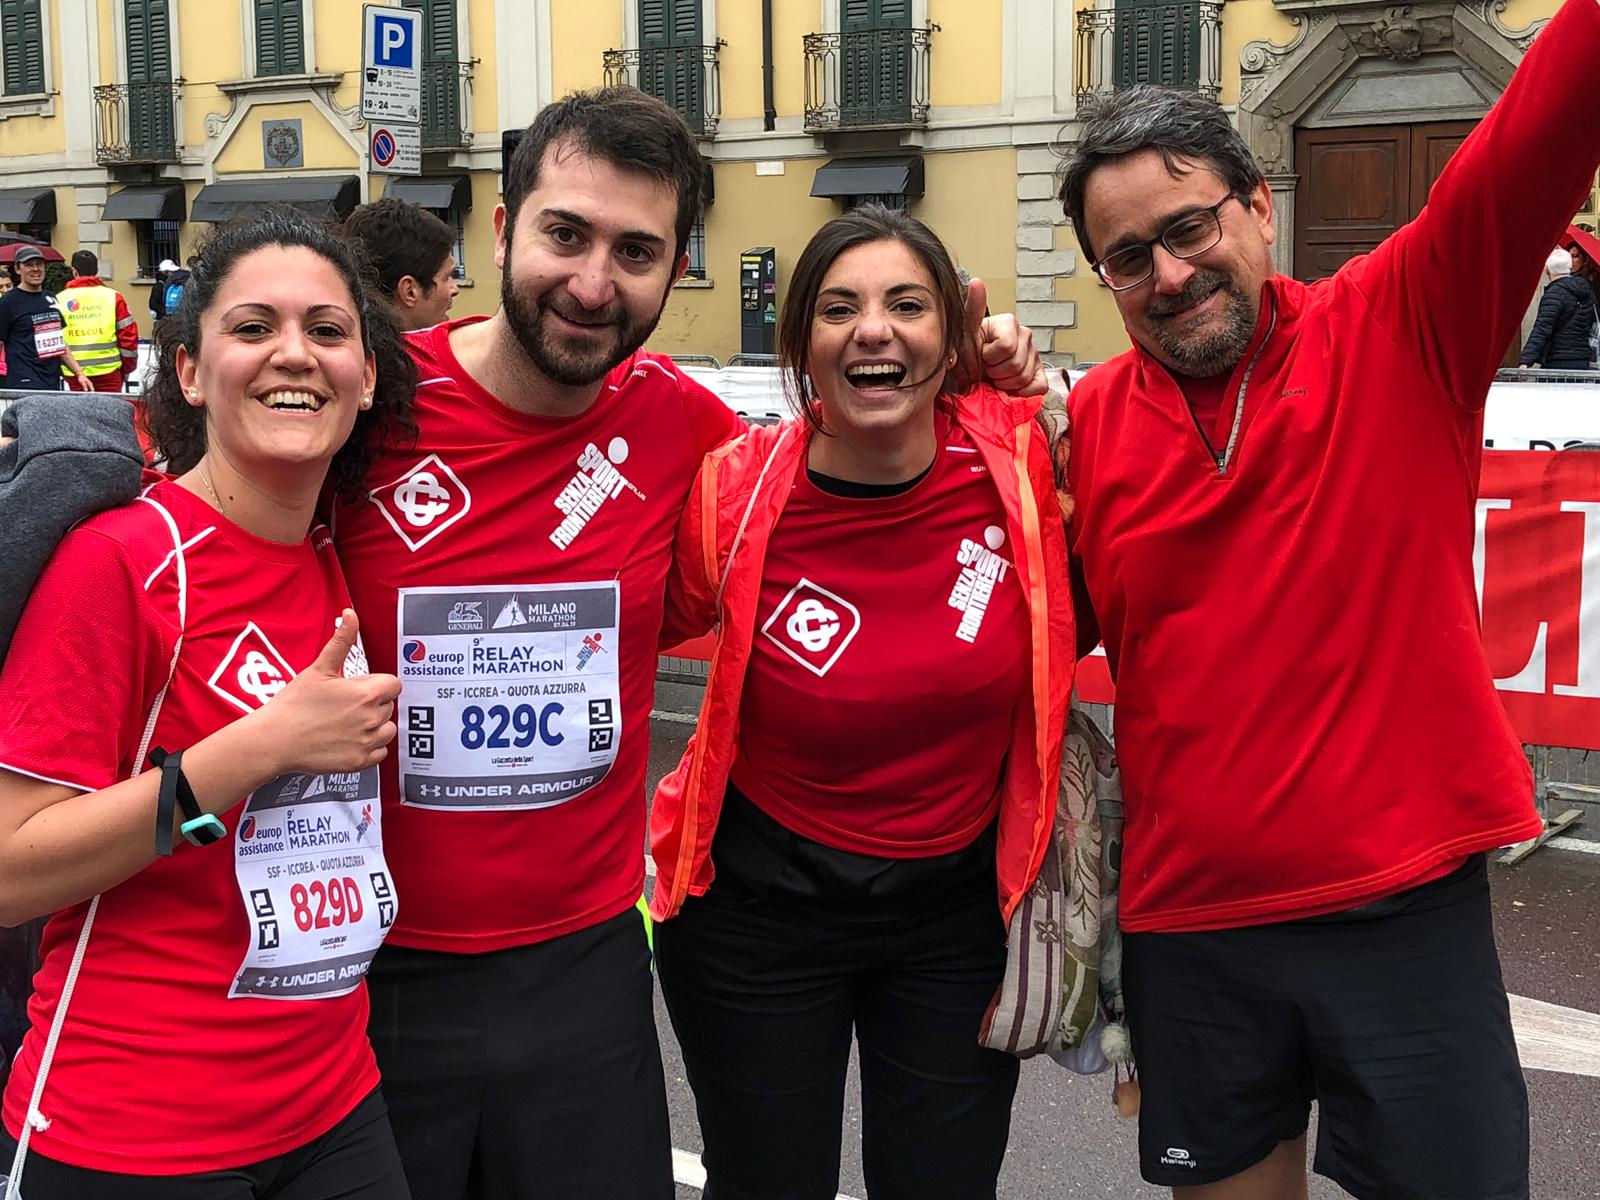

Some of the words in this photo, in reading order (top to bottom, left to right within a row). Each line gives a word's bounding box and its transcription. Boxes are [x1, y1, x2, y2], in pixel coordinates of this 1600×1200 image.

[383, 22, 406, 61] P
[364, 99, 373, 109] 19
[378, 100, 389, 110] 24
[767, 260, 774, 275] P
[68, 328, 104, 337] RESCUE
[577, 442, 629, 501] SPORT
[554, 470, 594, 516] SENZA
[548, 483, 609, 551] FRONTIERE
[956, 538, 1011, 584] SPORT
[948, 566, 979, 612] SENZA
[528, 601, 577, 615] MILANO
[955, 572, 997, 643] FRONTIERE
[447, 622, 483, 631] GENERALI
[528, 613, 576, 624] MARATHON
[429, 652, 465, 664] europ
[473, 645, 535, 661] RELAY
[403, 664, 465, 676] assistance
[473, 659, 564, 675] MARATHON
[437, 687, 455, 699] SSF
[464, 686, 499, 699] ICCREA
[507, 685, 541, 697] QUOTA
[542, 682, 587, 696] AZZURRA
[460, 702, 565, 750] 829C
[327, 771, 361, 785] MILANO
[445, 785, 512, 798] UNDER
[517, 775, 594, 796] ARMOUR
[256, 826, 283, 841] europ
[287, 816, 332, 835] RELAY
[239, 840, 285, 857] assistance
[289, 830, 351, 849] MARATHON
[267, 866, 282, 879] SSF
[287, 862, 315, 876] ICCREA
[320, 857, 343, 871] QUOTA
[290, 876, 364, 933] 829D
[281, 967, 336, 987] UNDER
